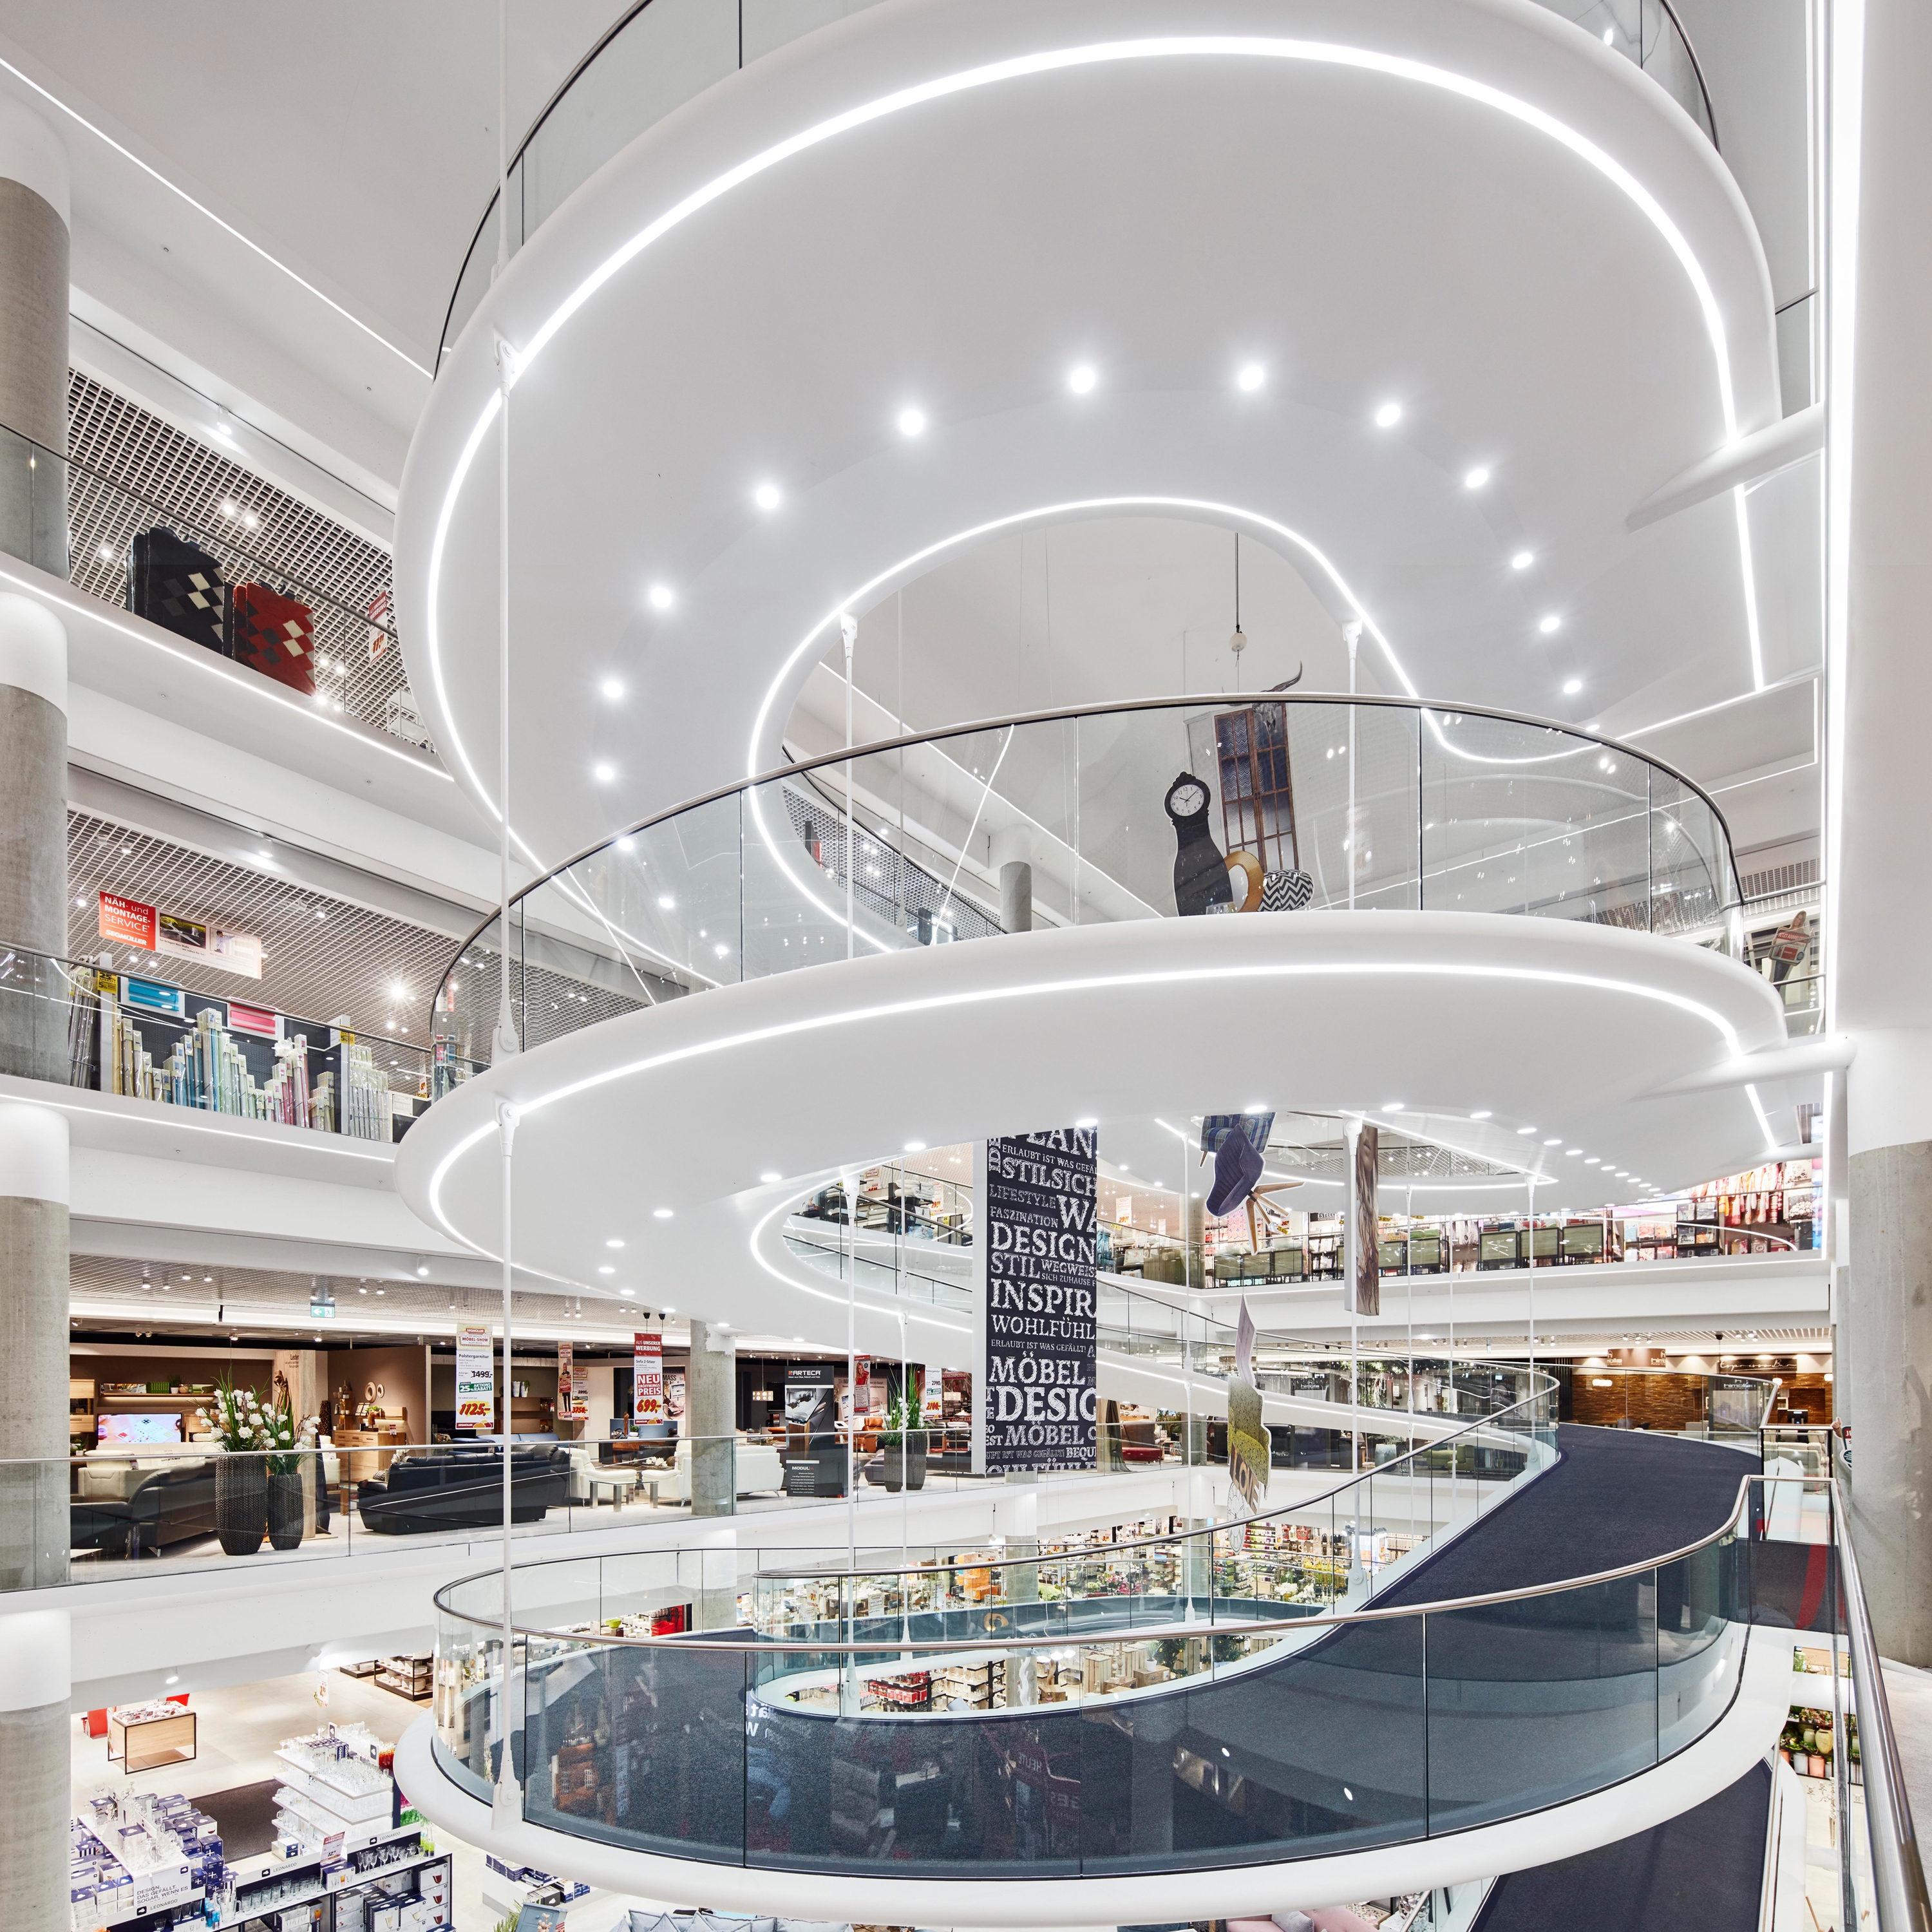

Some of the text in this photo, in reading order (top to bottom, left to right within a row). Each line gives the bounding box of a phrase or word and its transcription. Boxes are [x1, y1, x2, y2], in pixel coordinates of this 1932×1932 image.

[104, 896, 149, 915] NÄH- und
[104, 905, 151, 923] MONTAGE-
[105, 929, 147, 946] SEGMÜLLER
[1001, 1144, 1041, 1160] ERLAUBT
[1041, 1153, 1055, 1164] IST
[1056, 1157, 1074, 1170] WAS
[989, 1184, 1056, 1209] LIFESTYLE
[989, 1205, 1059, 1229] FASZINATION
[990, 1220, 1096, 1264] DESIGN
[990, 1251, 1041, 1279] STIL
[1041, 1258, 1097, 1278] WEGWEIS
[1041, 1273, 1058, 1282] SICH
[1059, 1275, 1091, 1287] ZUHAUSE
[990, 1339, 1086, 1353] ERLAUBT IST WAS GEFÄLLT!
[989, 1350, 1086, 1385] MÖBEL
[1719, 1359, 1797, 1371] Espresso Bar
[637, 1374, 661, 1384] NEU
[638, 1387, 661, 1396] PREIS
[459, 1403, 491, 1417] 1125,-
[636, 1399, 661, 1414] 699,-
[1004, 1420, 1084, 1446] MÖBEL
[1002, 1450, 1015, 1459] IST
[1016, 1450, 1032, 1459] WAS
[379, 1831, 401, 1841] LEONARDO
[273, 1862, 298, 1873] LEONARDO
[137, 1885, 161, 1895] DESIGN.
[151, 1884, 177, 1895] GEFÄLLT.
[161, 1888, 179, 1897] WENN
[150, 1899, 178, 1910] LEONARDO
